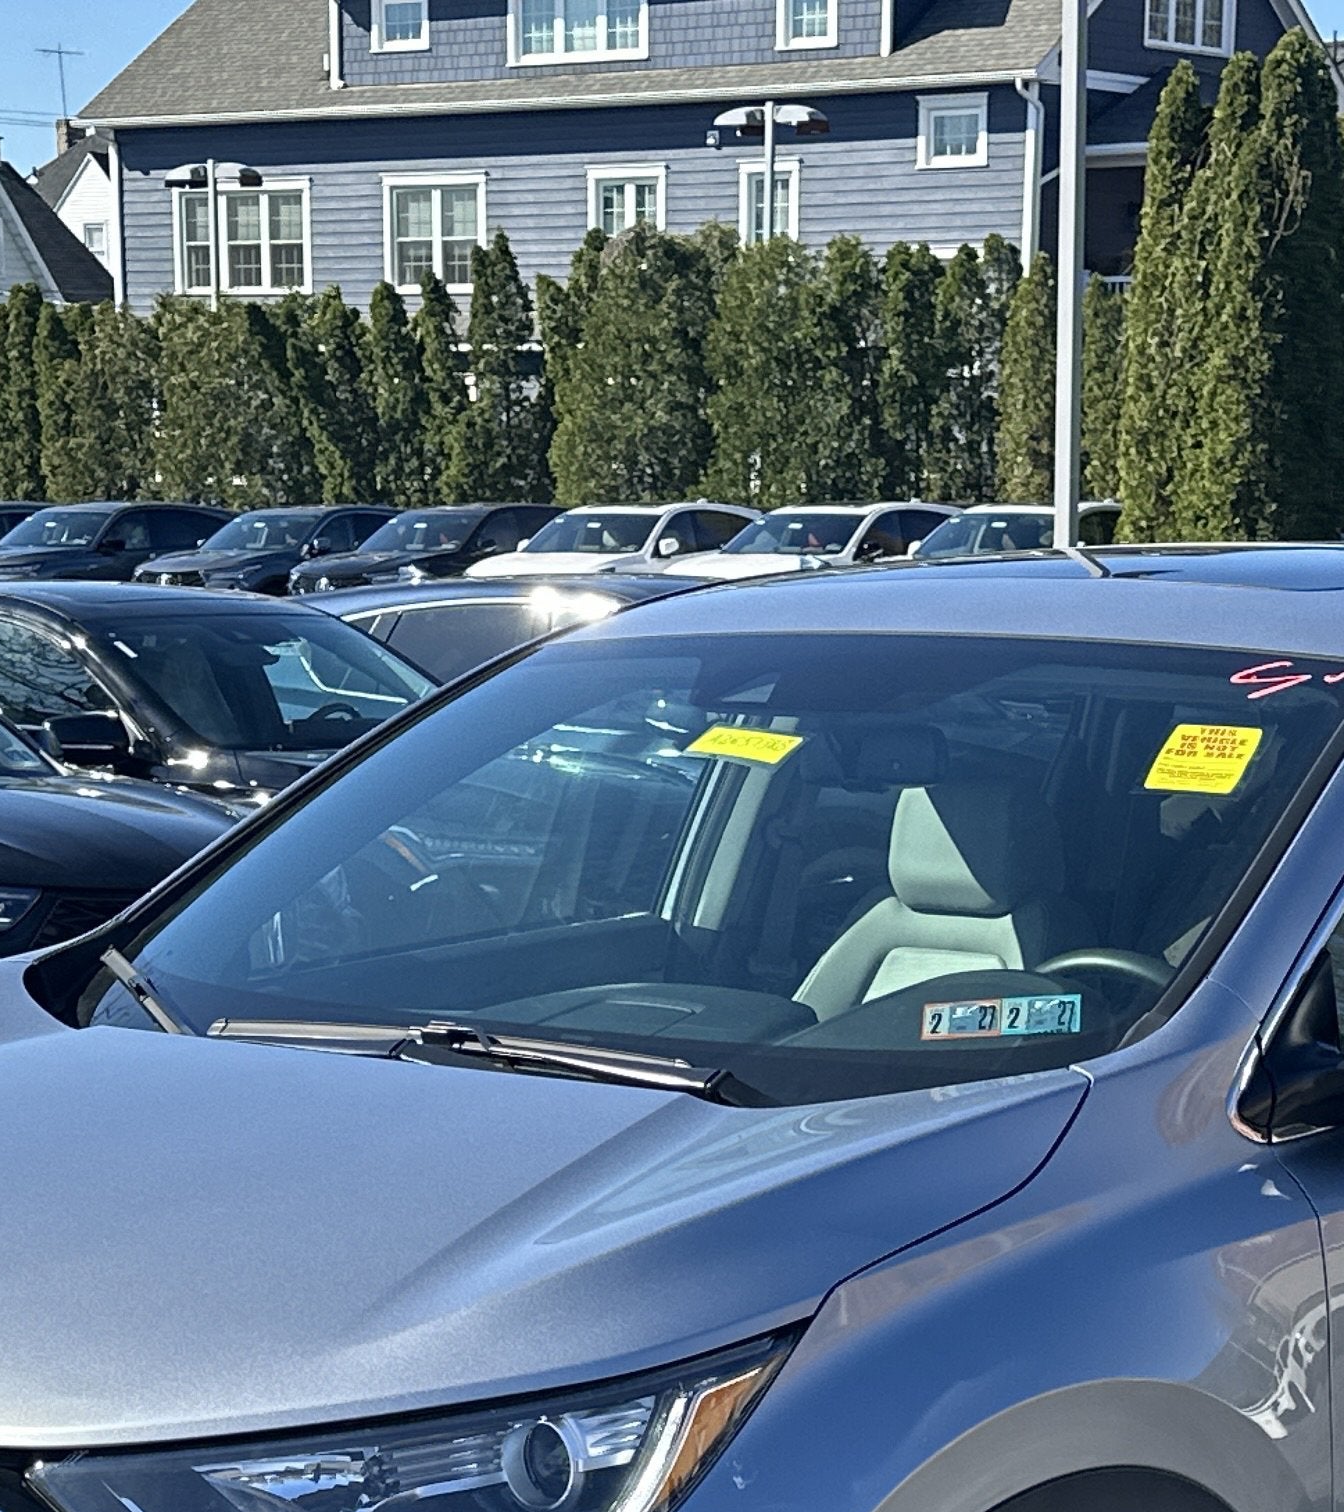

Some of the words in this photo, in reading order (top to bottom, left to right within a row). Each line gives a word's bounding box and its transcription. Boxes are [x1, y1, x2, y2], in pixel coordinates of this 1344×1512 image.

[1181, 734, 1248, 746] VEHICLE
[1165, 748, 1199, 757] FOR
[1203, 744, 1239, 752] NOT
[929, 1013, 942, 1034] 2
[978, 1005, 996, 1031] 27
[1007, 1007, 1020, 1029] 2
[1057, 1000, 1076, 1032] 27
